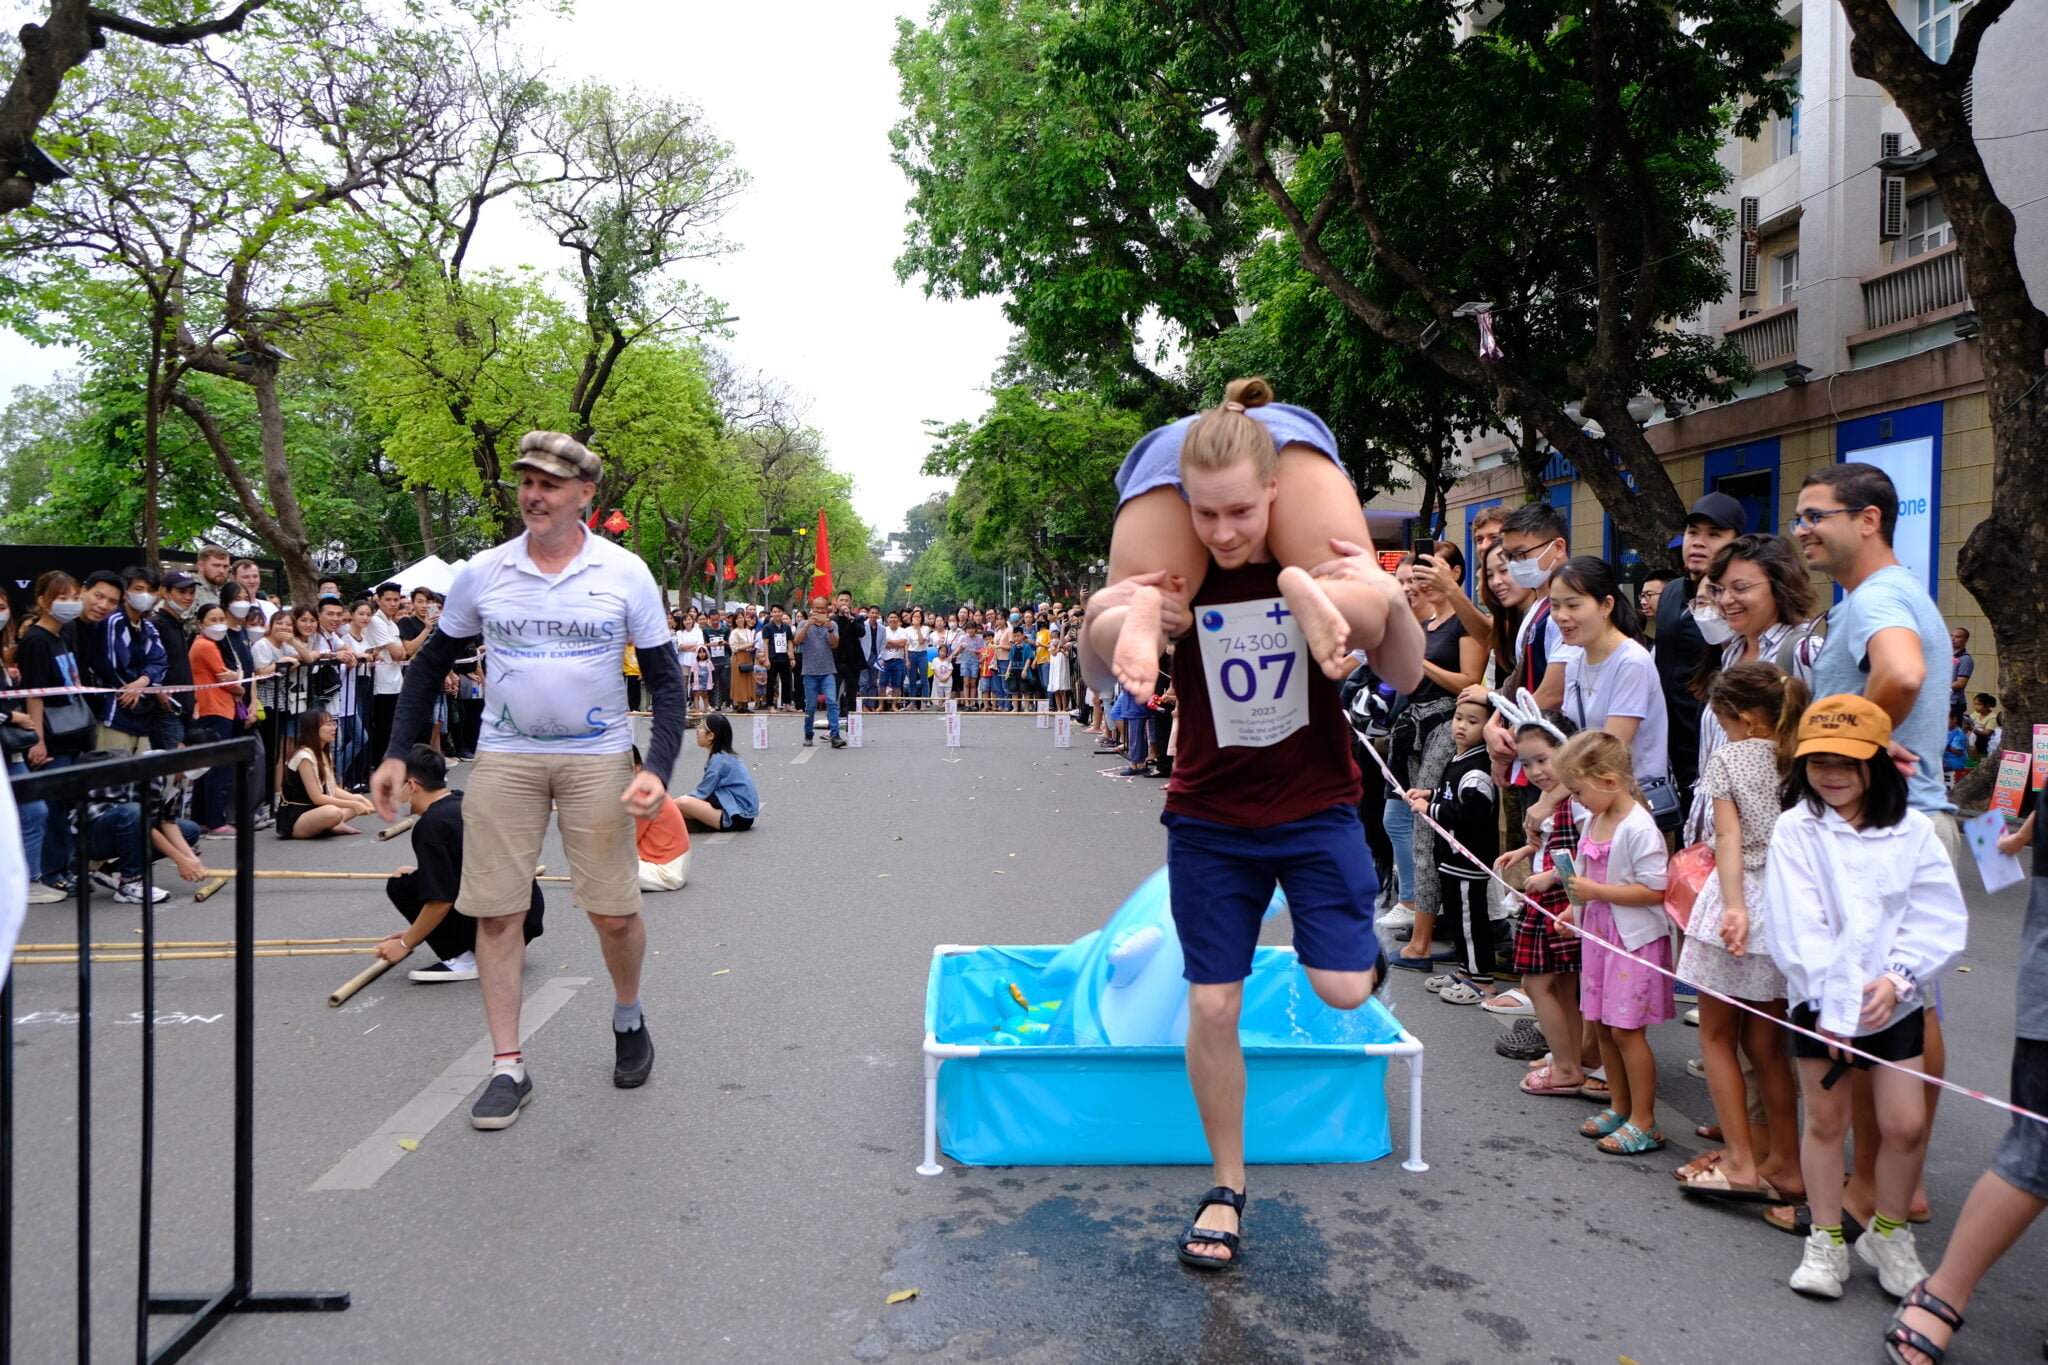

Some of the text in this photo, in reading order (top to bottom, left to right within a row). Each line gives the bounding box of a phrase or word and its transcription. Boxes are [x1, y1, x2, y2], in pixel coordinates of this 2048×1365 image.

[1219, 632, 1288, 654] 74300
[1220, 651, 1297, 703] 07
[1251, 706, 1277, 717] 2023
